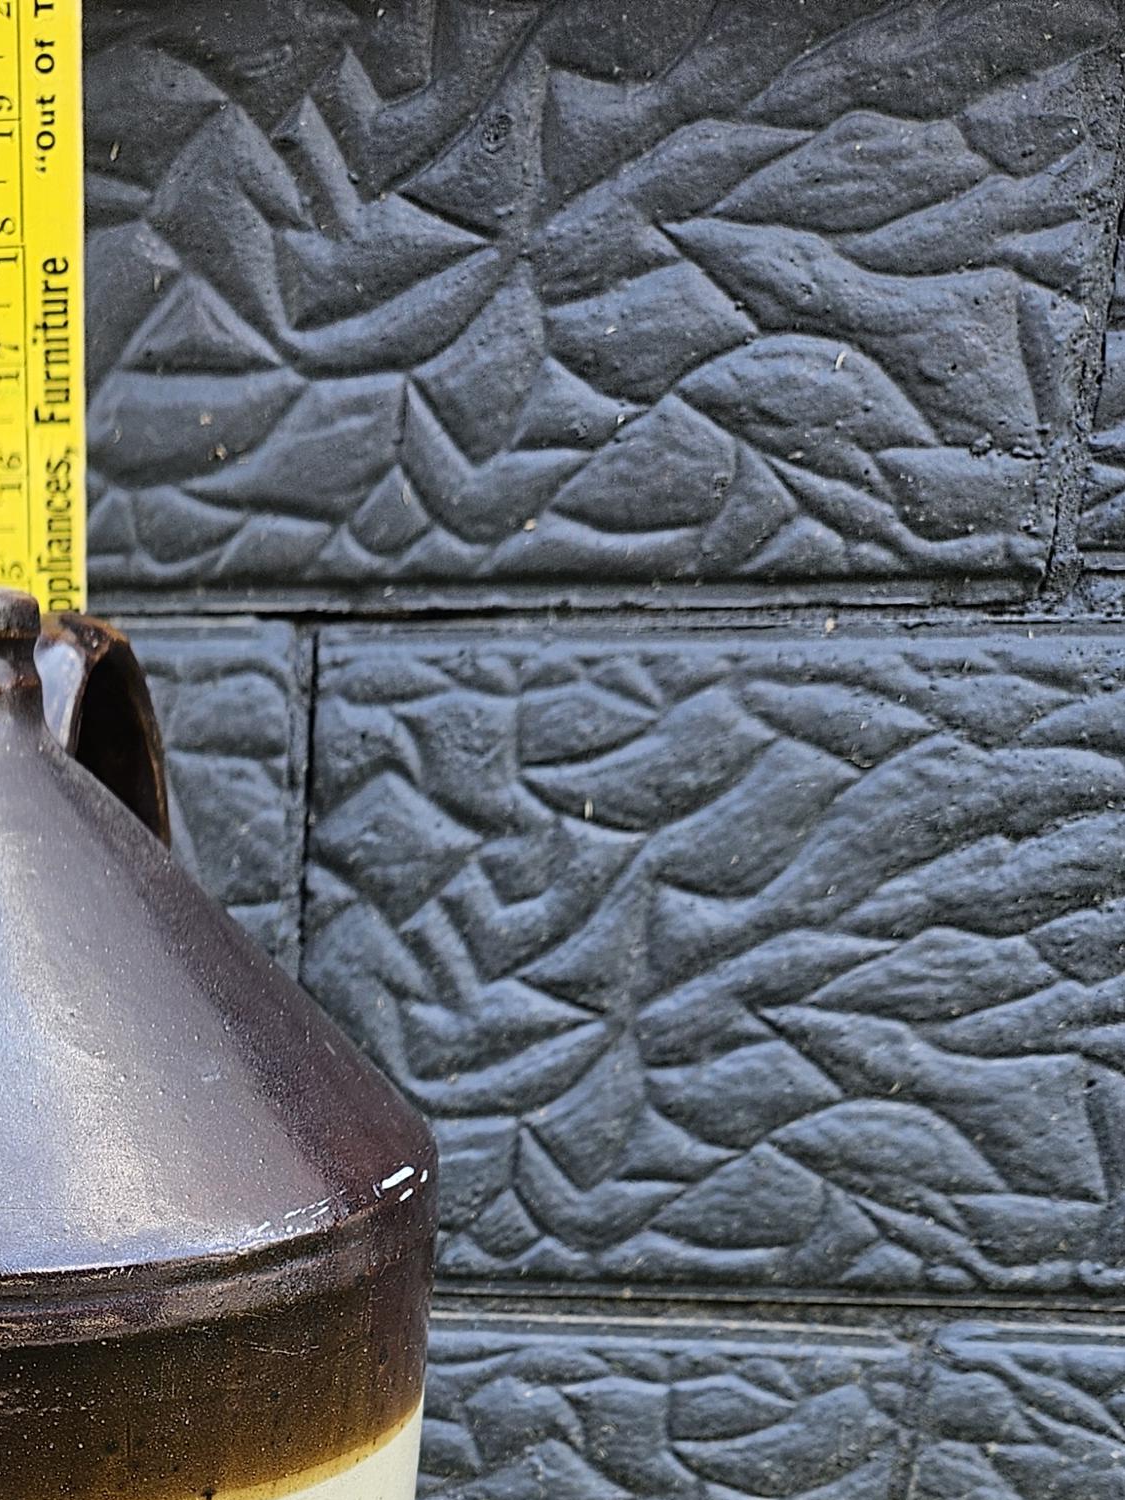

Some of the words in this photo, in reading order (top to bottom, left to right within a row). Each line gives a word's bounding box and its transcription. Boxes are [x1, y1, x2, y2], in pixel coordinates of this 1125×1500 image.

[33, 0, 54, 18] T
[34, 37, 55, 75] Of
[33, 257, 70, 426] Furniture
[37, 445, 81, 612] ppliances,
[0, 560, 24, 579] 5
